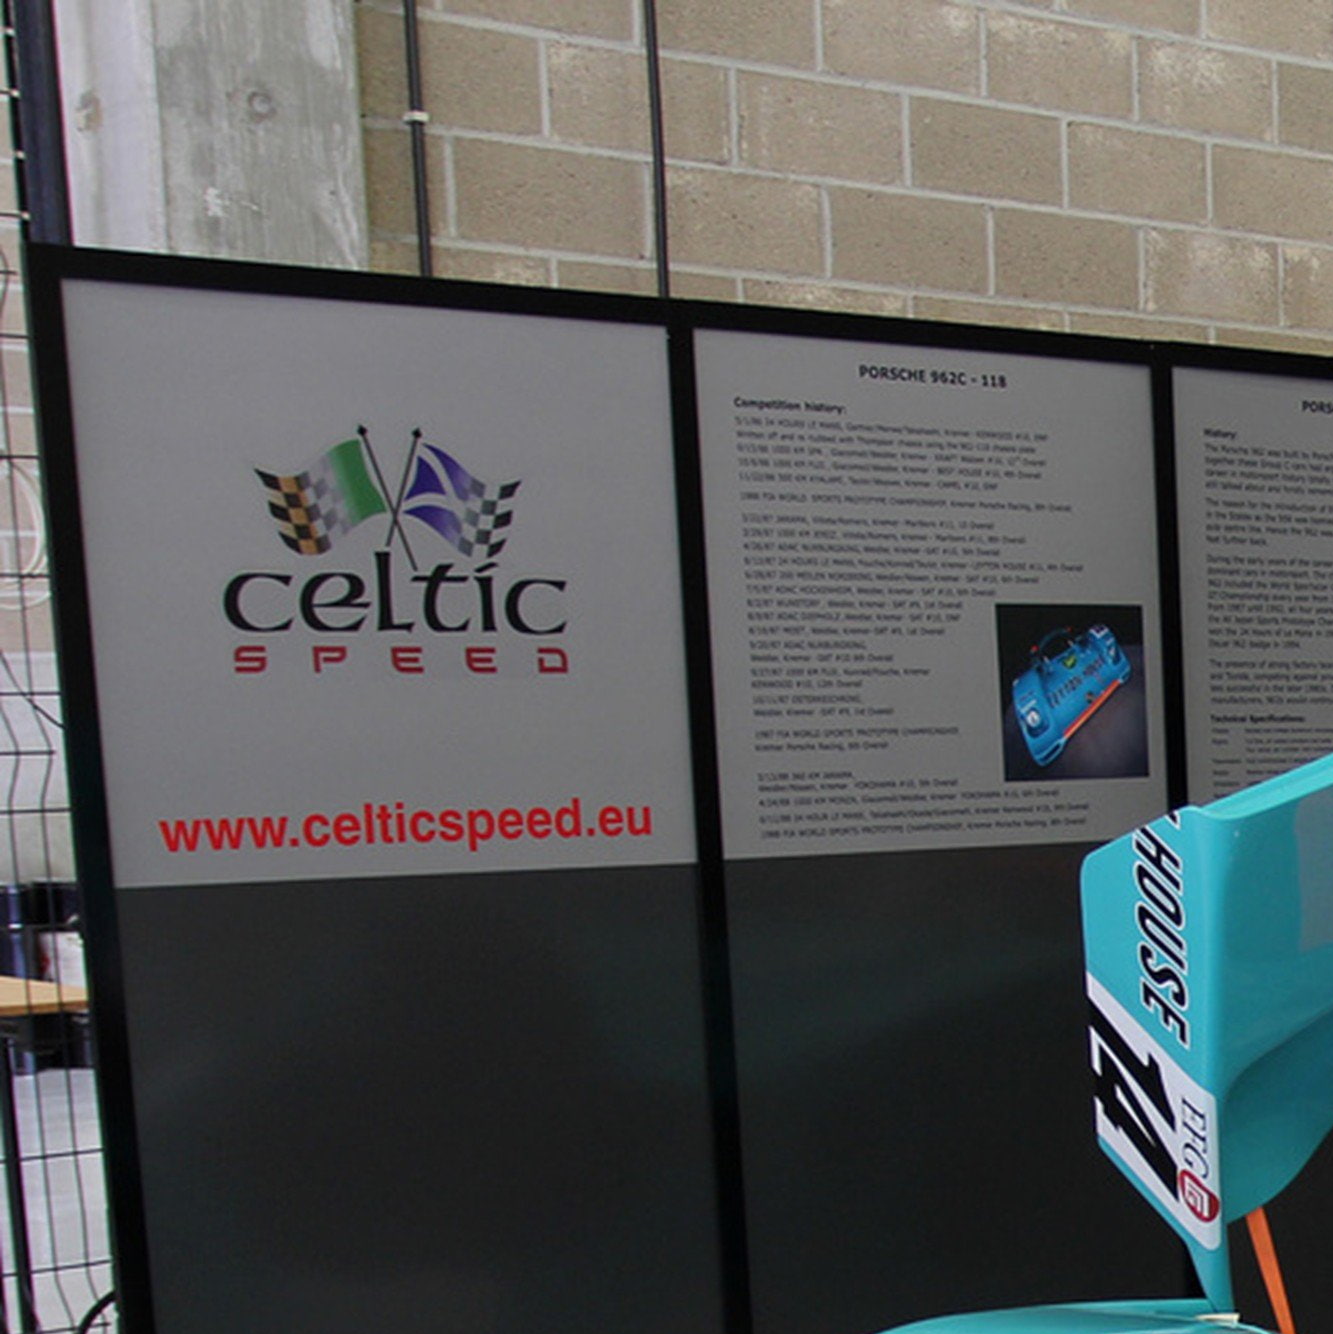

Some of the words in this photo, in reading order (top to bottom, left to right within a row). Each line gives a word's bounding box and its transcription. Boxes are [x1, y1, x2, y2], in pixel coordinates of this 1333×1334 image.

[859, 364, 926, 385] PORSCHE
[930, 369, 968, 386] 962C
[222, 551, 568, 635] celtic
[233, 645, 569, 674] SPEED
[159, 797, 652, 852] www.celticspeed.eu
[1131, 826, 1191, 1050] HOUSE
[1088, 1003, 1180, 1203] 14
[1179, 1095, 1208, 1182] EFG
